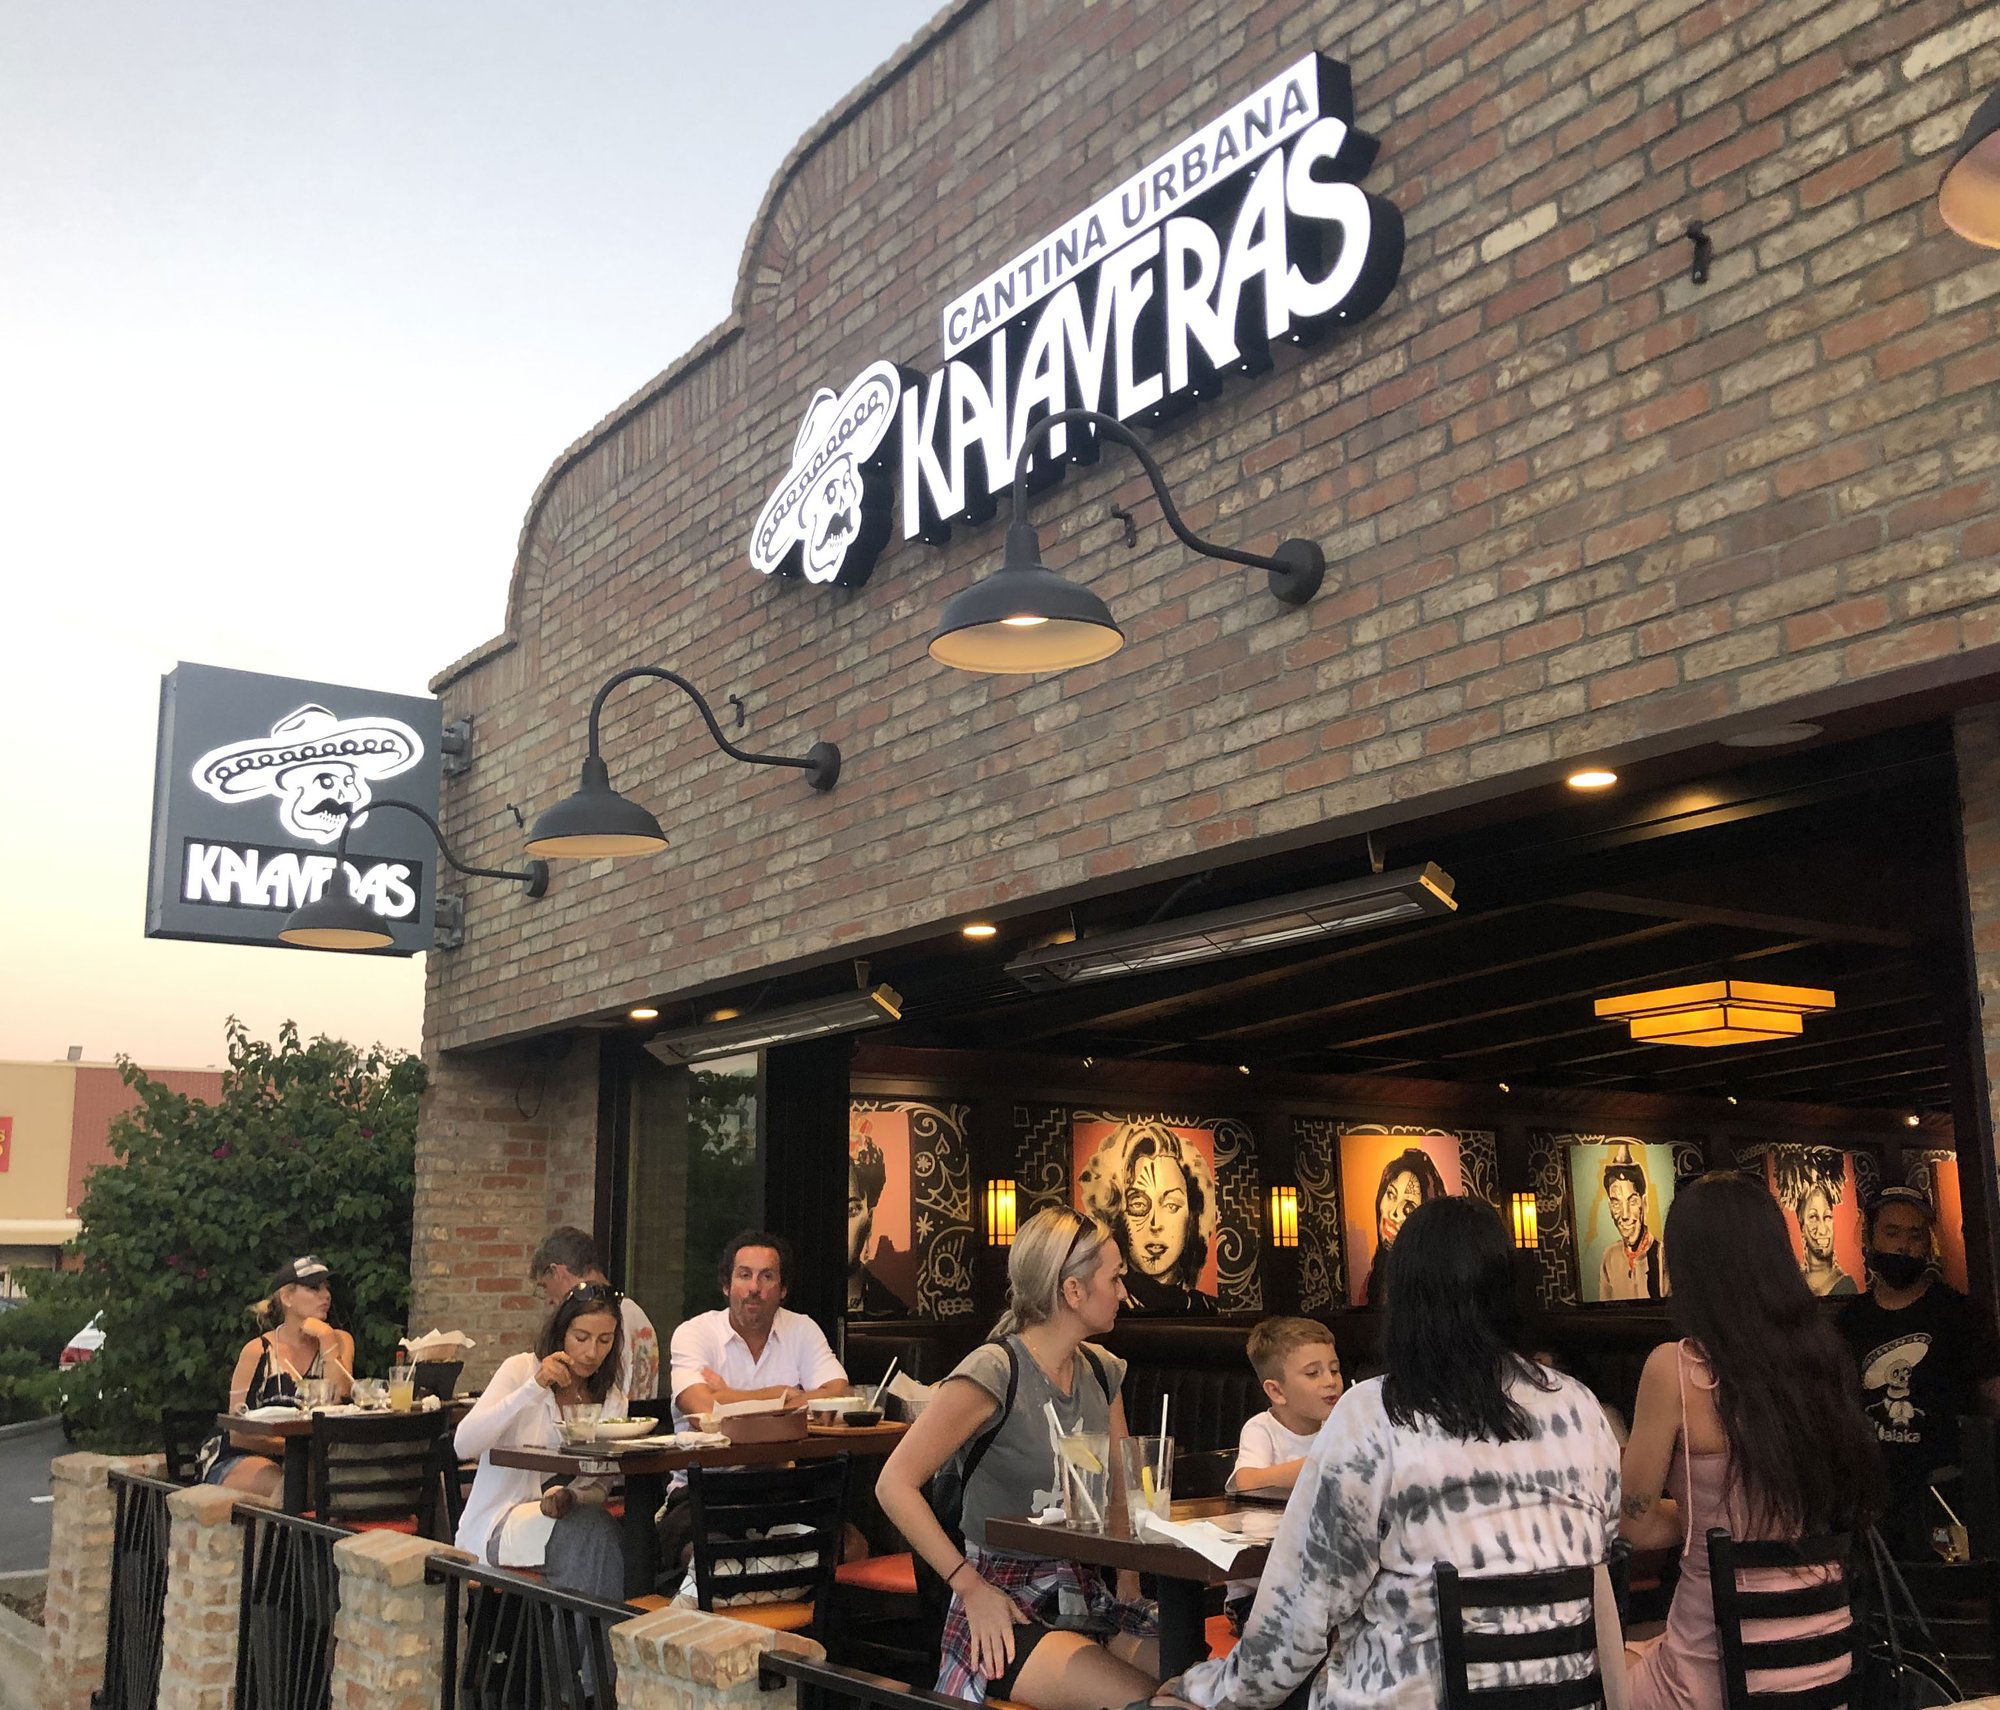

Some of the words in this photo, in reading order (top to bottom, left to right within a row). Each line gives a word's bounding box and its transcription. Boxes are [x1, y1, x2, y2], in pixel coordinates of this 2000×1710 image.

[903, 116, 1371, 540] KALAVERAS
[949, 214, 1107, 345] CANTINA
[1122, 79, 1309, 228] URBANA
